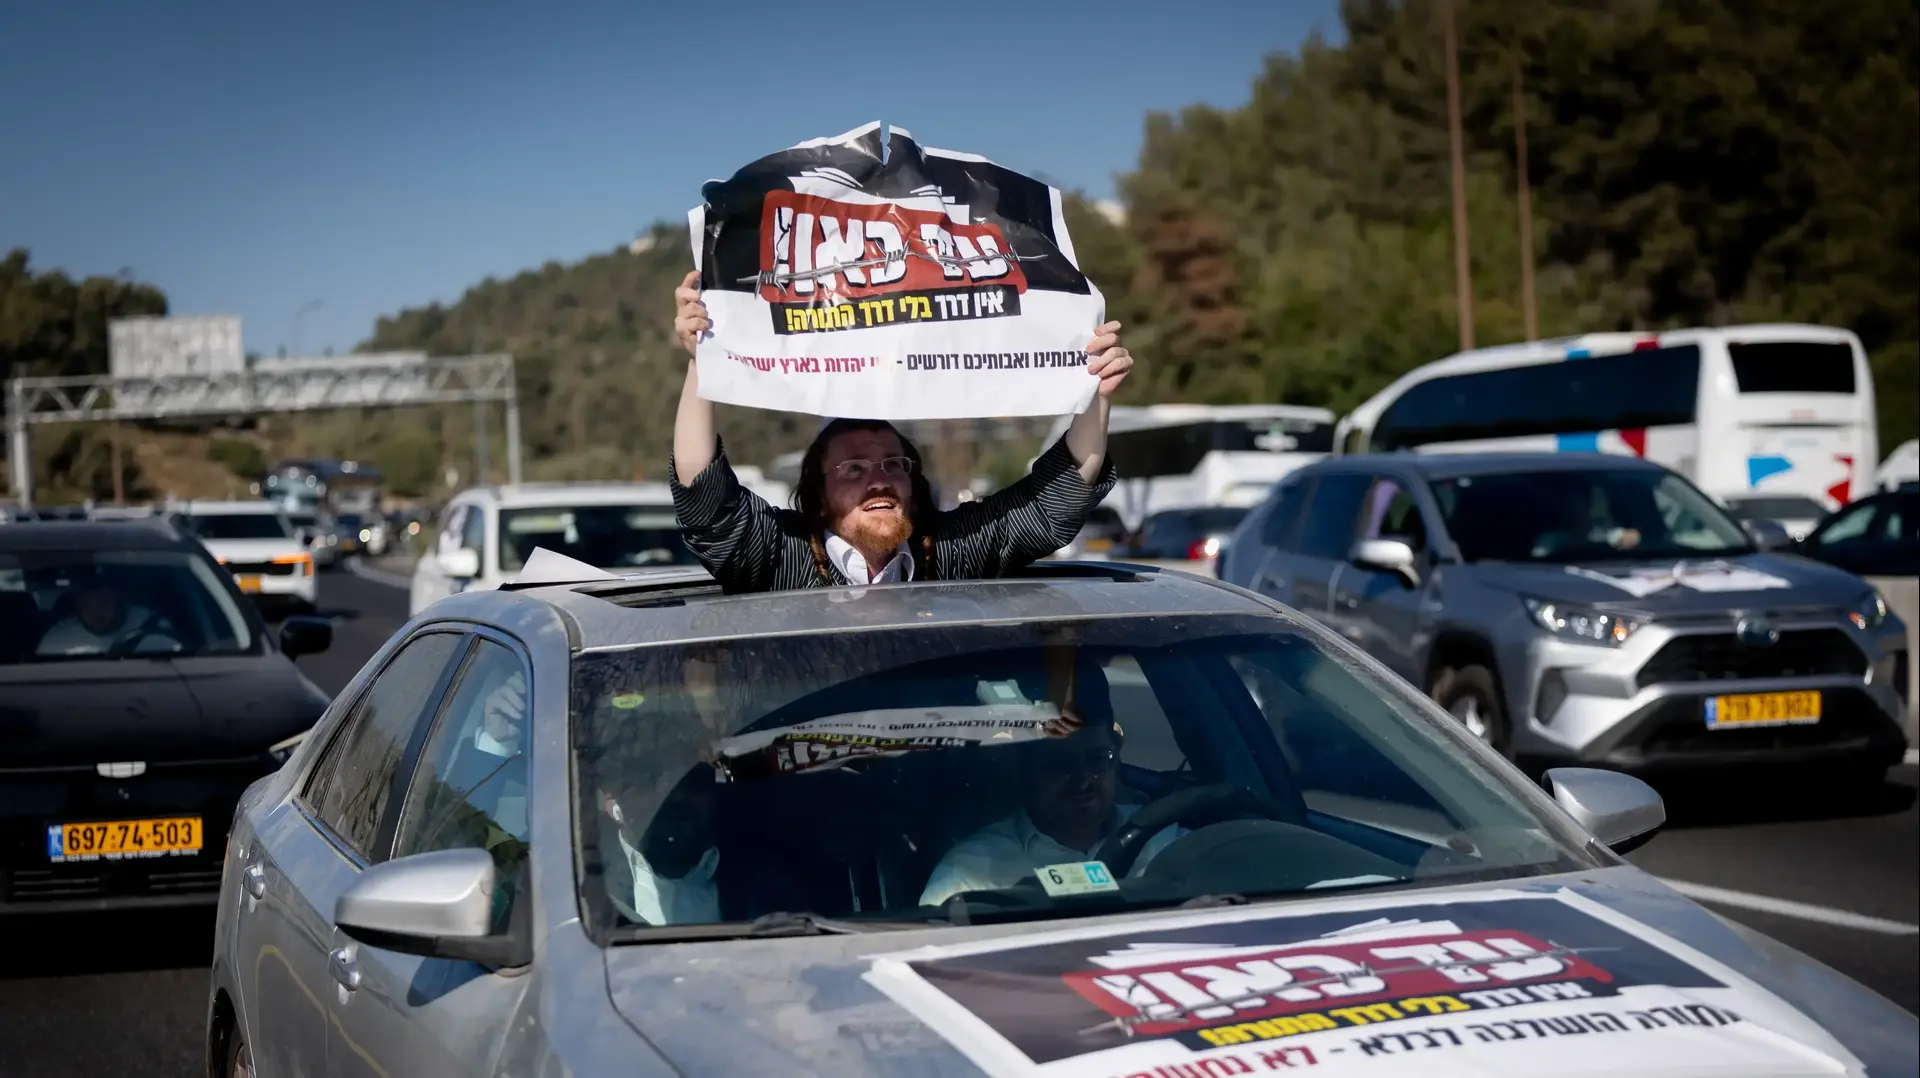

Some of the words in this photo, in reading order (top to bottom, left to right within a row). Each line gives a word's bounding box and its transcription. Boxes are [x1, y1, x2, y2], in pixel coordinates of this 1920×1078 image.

[772, 206, 908, 295] כאן!
[920, 222, 1008, 282] עד
[859, 298, 894, 327] דרך
[900, 295, 932, 319] בלי
[935, 293, 969, 319] דרך
[973, 290, 1004, 318] אין
[785, 304, 855, 332] התורה!
[779, 357, 821, 374] בארץ
[825, 356, 865, 373] יהדות
[907, 353, 959, 371] דורשים
[963, 352, 1029, 370] ואבותיכם
[1034, 350, 1089, 369] אבותינו
[1048, 868, 1063, 885] 6
[1369, 937, 1563, 984] עד
[1460, 987, 1527, 1009] דרך
[1529, 981, 1592, 1002] אין
[1328, 1002, 1405, 1026] דרך
[1398, 994, 1473, 1017] בלי
[1197, 1013, 1338, 1047] התורה!
[1466, 1011, 1630, 1043] הושלכה
[1353, 1025, 1463, 1057] לכלא
[1256, 1044, 1319, 1071] לא
